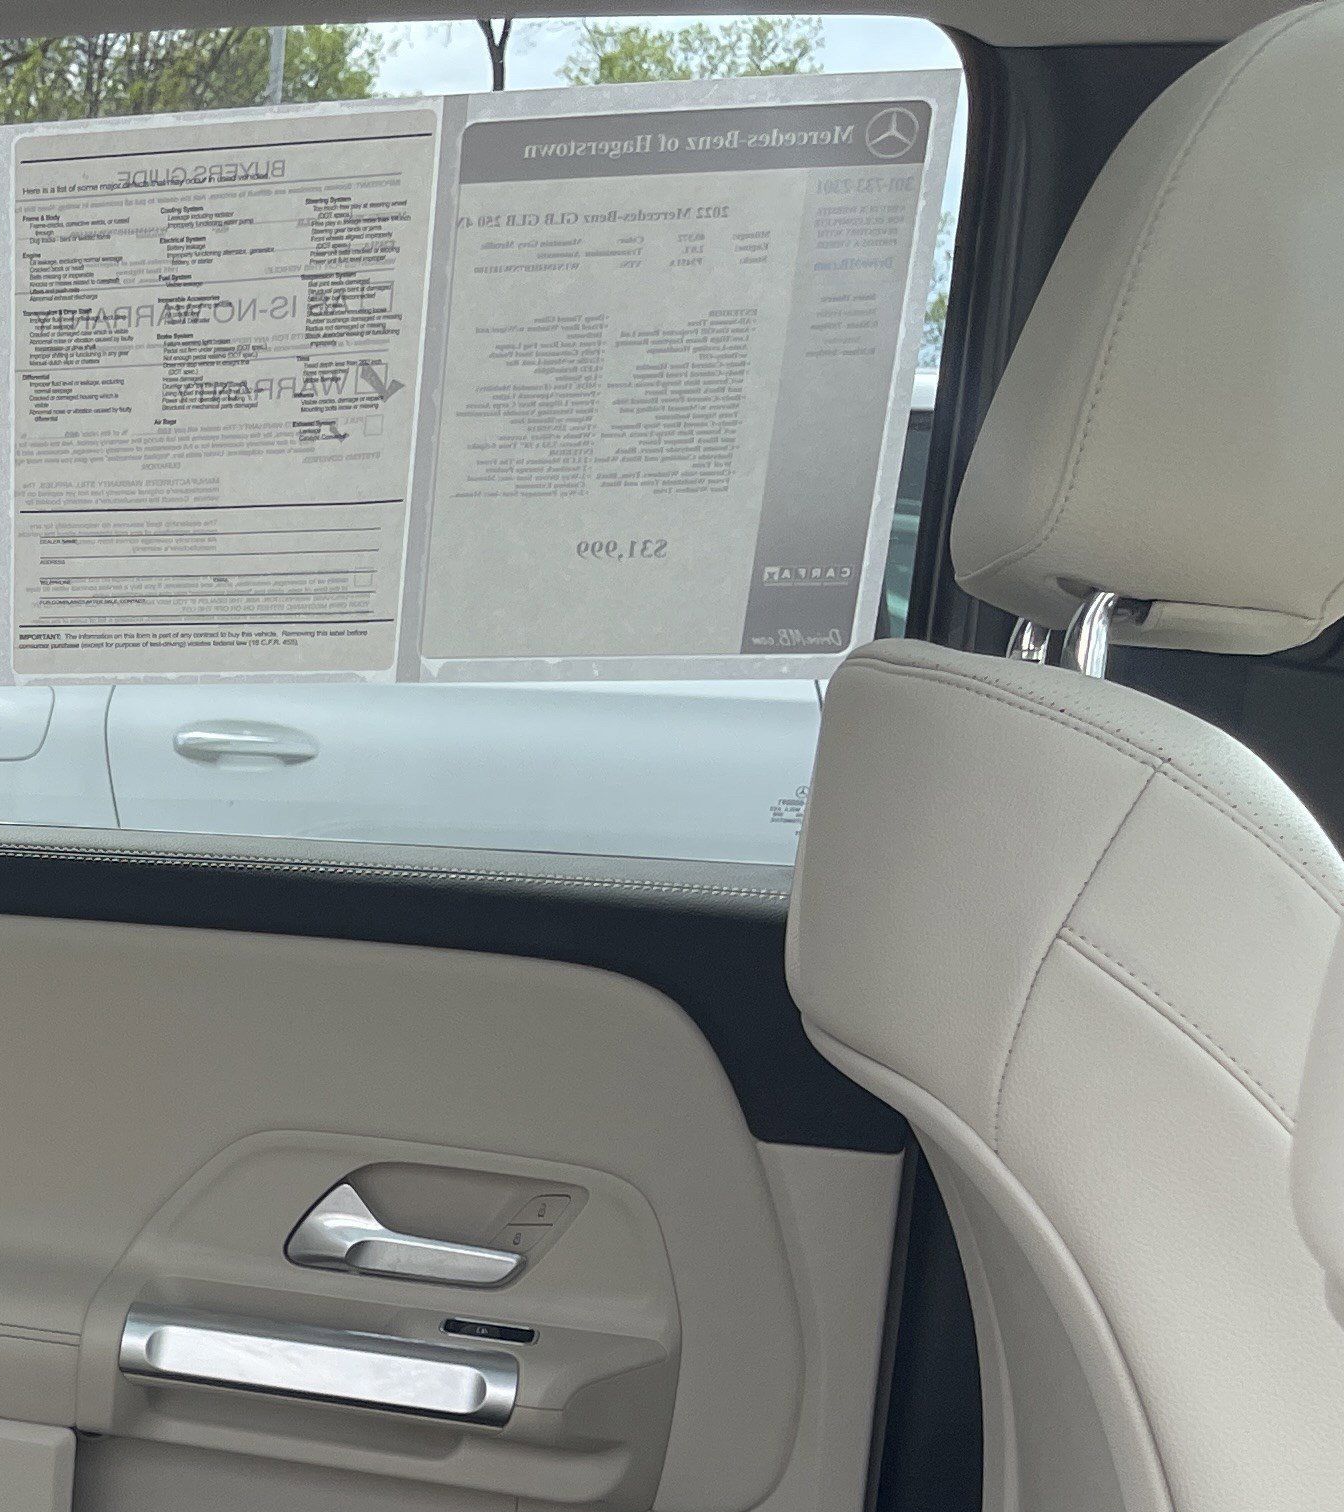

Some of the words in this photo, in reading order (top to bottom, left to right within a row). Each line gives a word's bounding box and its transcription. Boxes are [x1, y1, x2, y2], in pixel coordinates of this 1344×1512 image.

[23, 186, 40, 195] Here
[159, 631, 171, 640] part
[228, 630, 240, 639] buy
